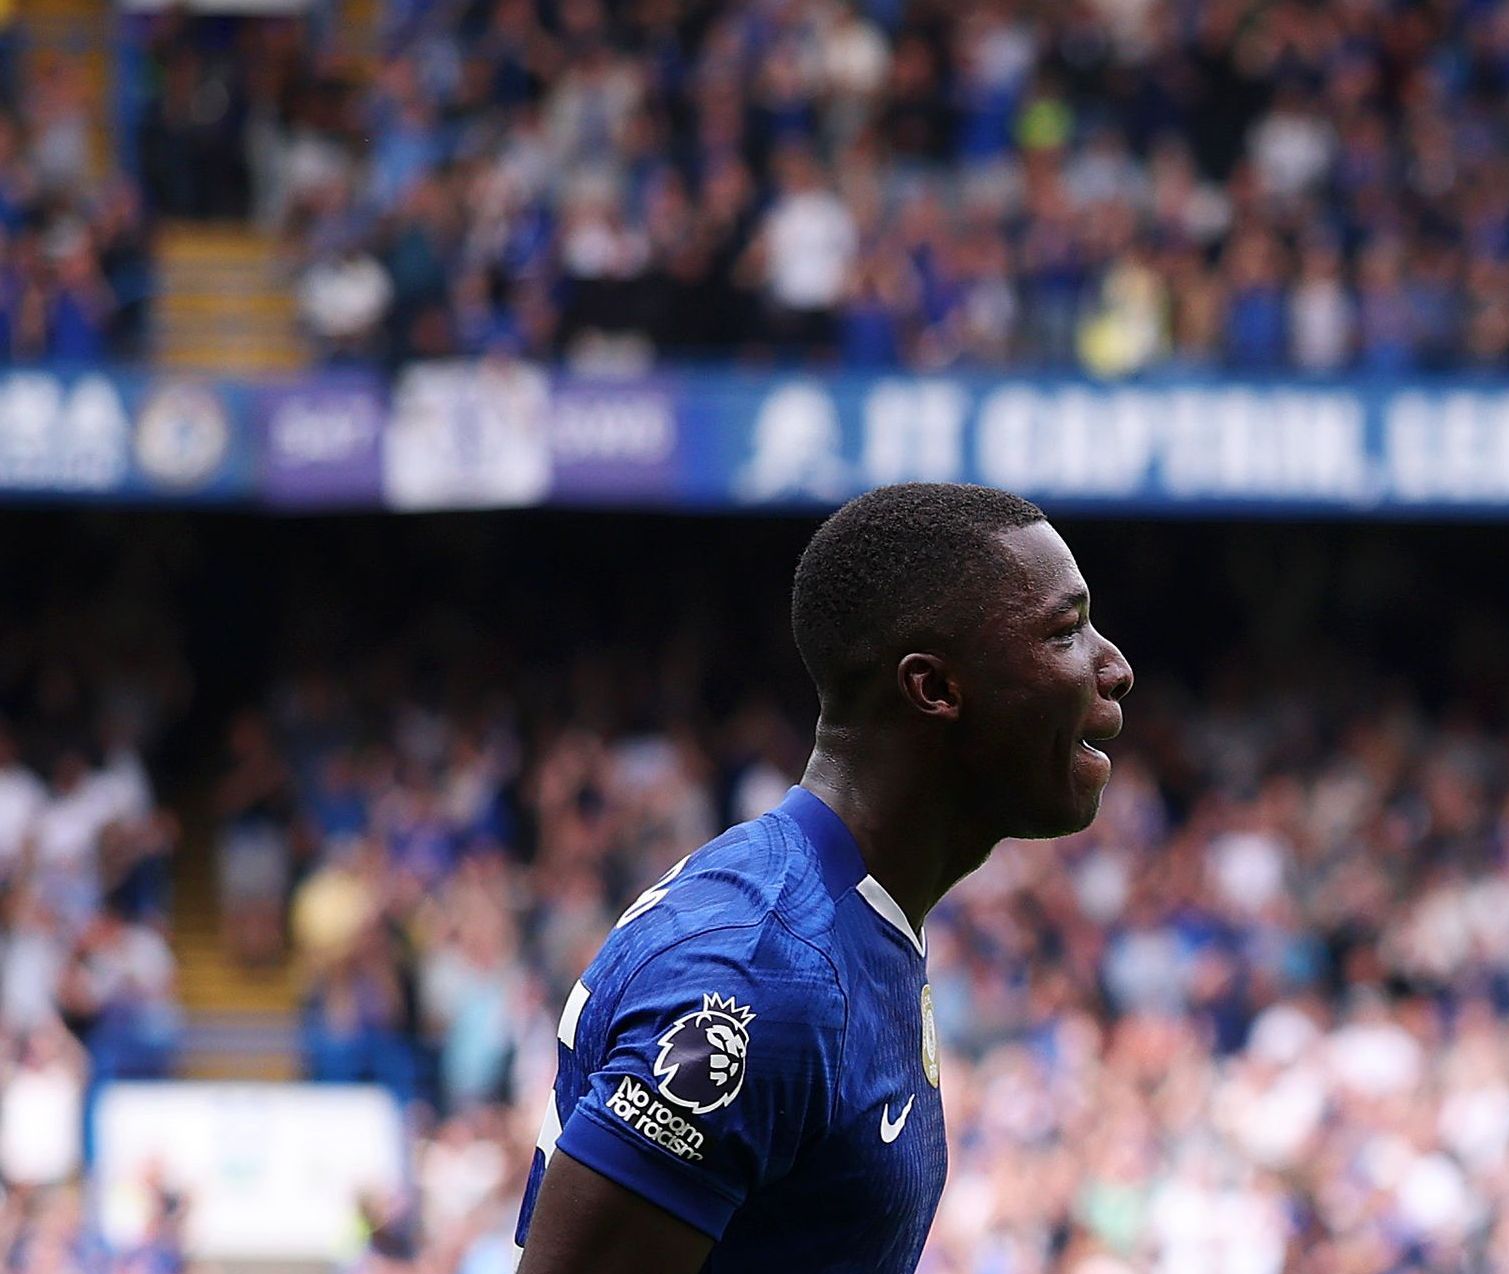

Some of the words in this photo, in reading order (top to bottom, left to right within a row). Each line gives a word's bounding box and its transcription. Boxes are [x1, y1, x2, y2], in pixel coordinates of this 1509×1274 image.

[605, 1091, 641, 1122] for
[634, 1114, 704, 1161] racism
[617, 1075, 650, 1108] No
[646, 1100, 704, 1149] room
